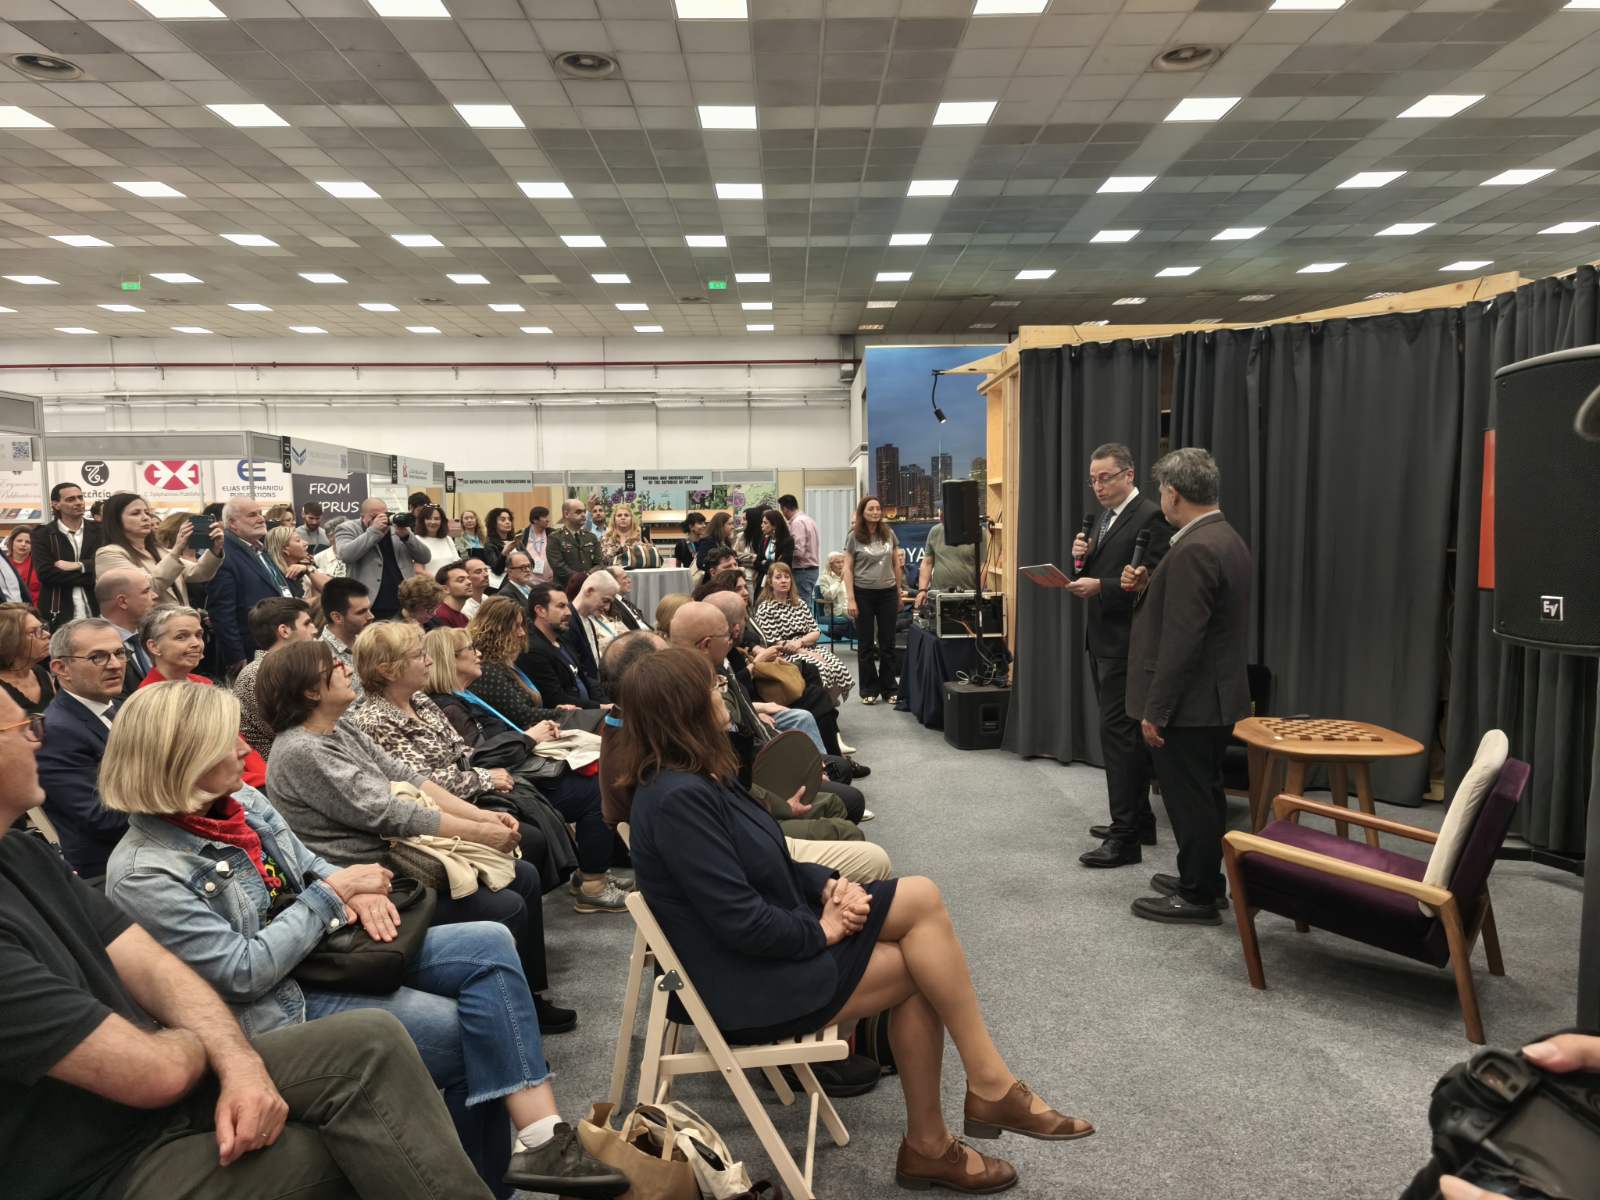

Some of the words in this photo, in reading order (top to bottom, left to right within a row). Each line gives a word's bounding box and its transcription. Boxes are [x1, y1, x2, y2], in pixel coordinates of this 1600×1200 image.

[309, 483, 351, 495] FROM
[319, 501, 361, 514] PRUS
[1543, 600, 1559, 617] EV
